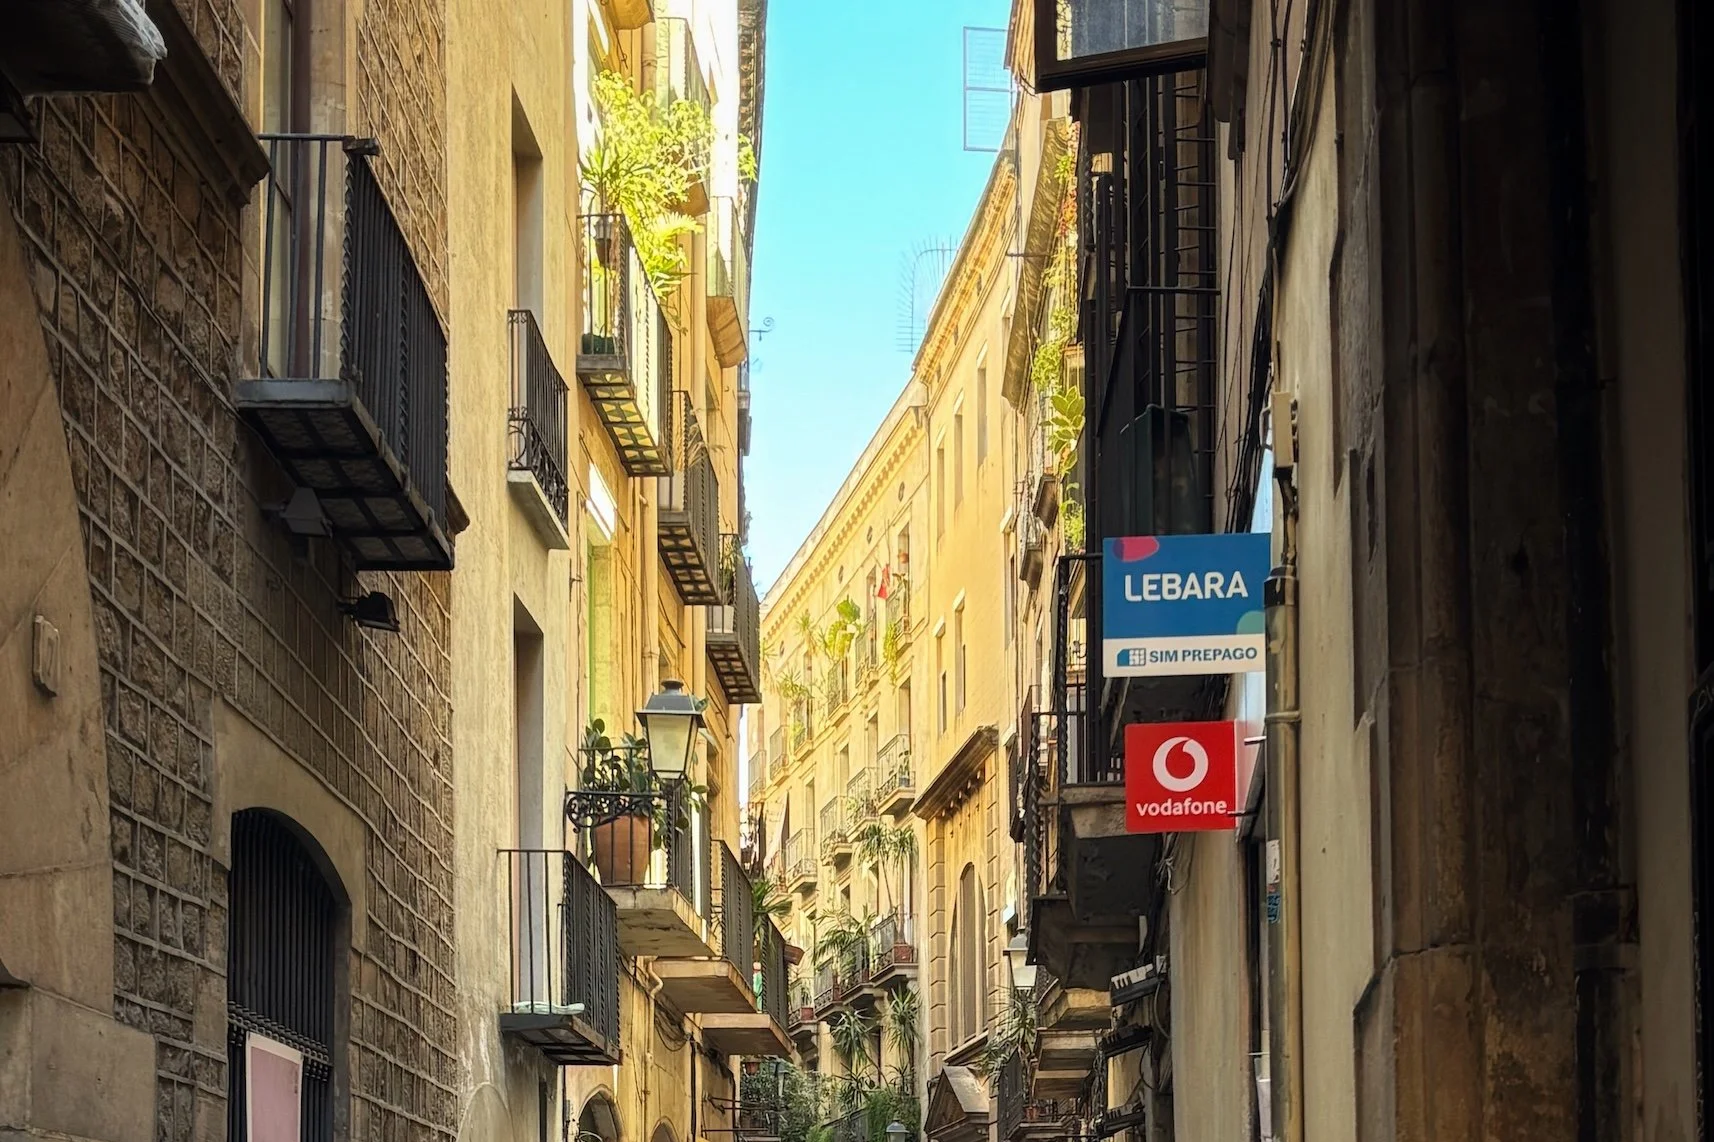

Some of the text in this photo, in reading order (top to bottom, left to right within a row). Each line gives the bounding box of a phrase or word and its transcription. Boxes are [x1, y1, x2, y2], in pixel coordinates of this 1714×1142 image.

[1124, 570, 1249, 602] LEBARA
[1149, 647, 1258, 664] SIM PREPAGO
[1136, 797, 1228, 817] vodafone
